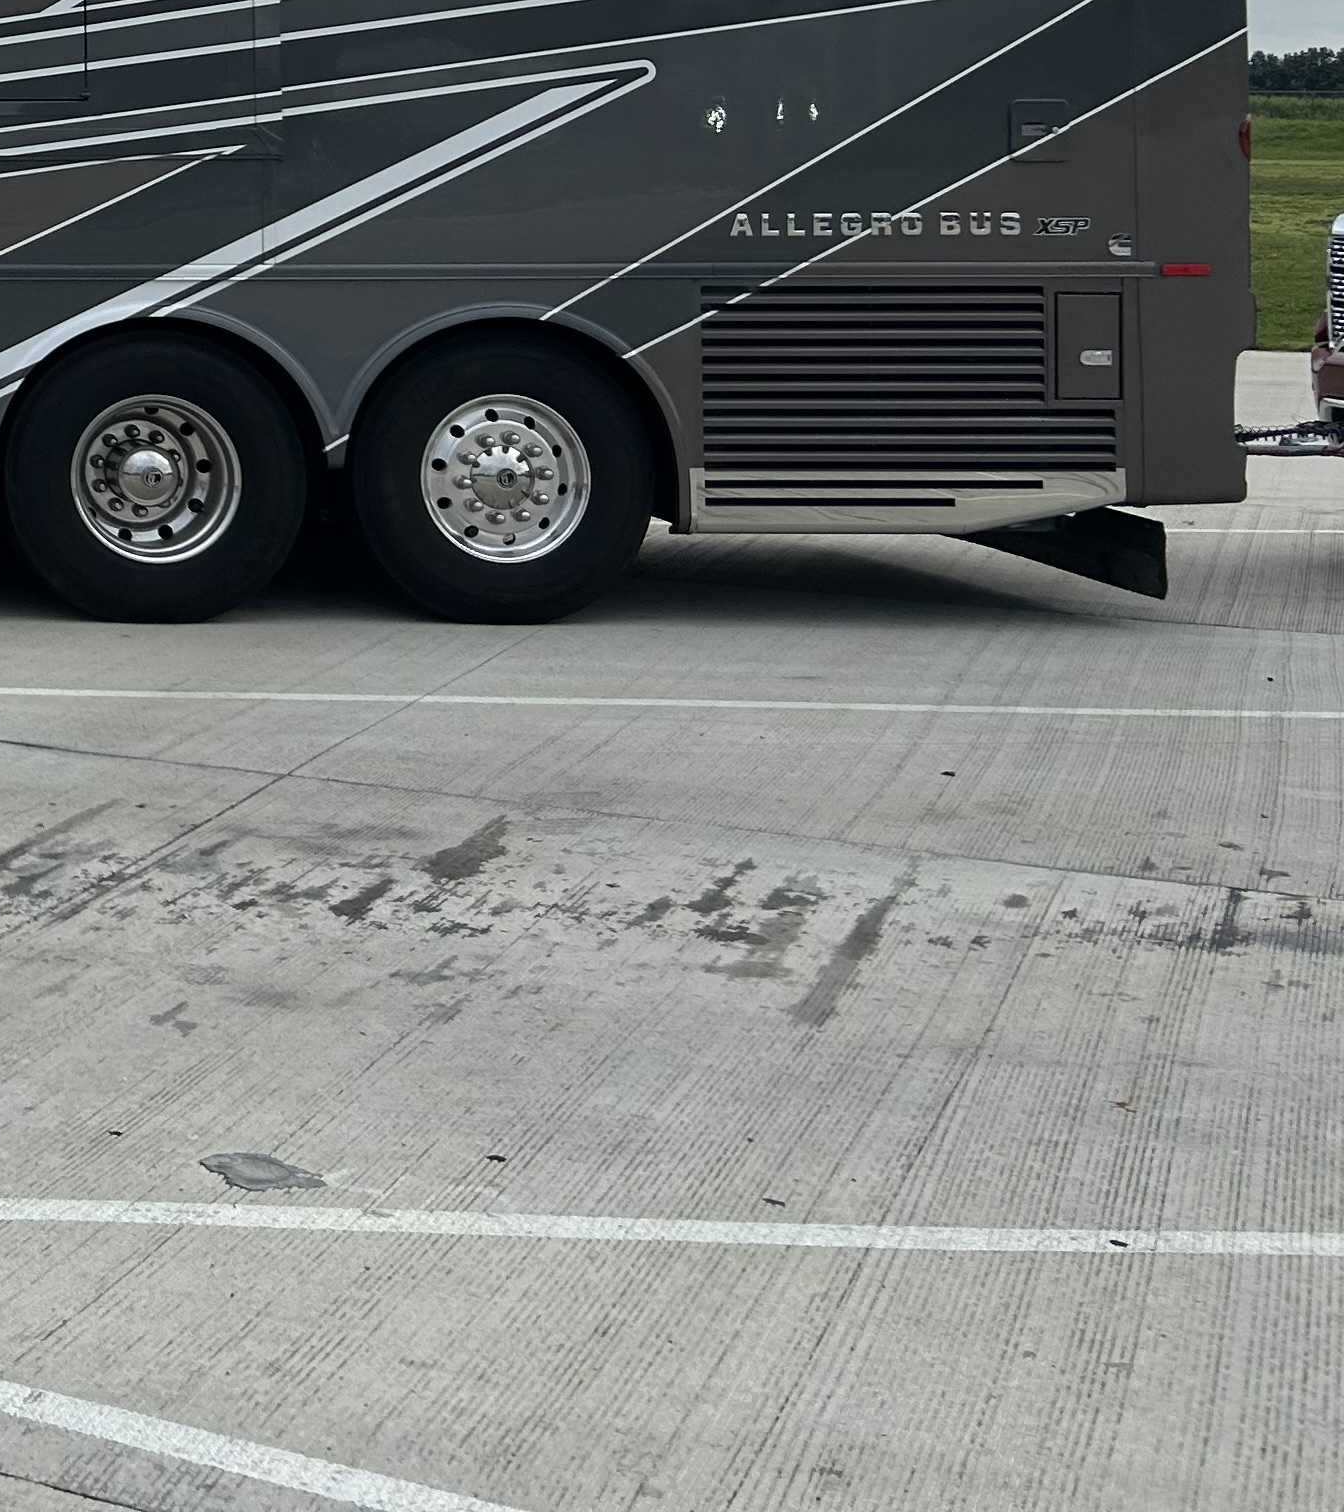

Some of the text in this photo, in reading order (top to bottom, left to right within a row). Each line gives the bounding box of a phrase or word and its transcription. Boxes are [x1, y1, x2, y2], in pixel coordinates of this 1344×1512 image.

[729, 211, 1091, 237] ALLEGRO BUS XSP
